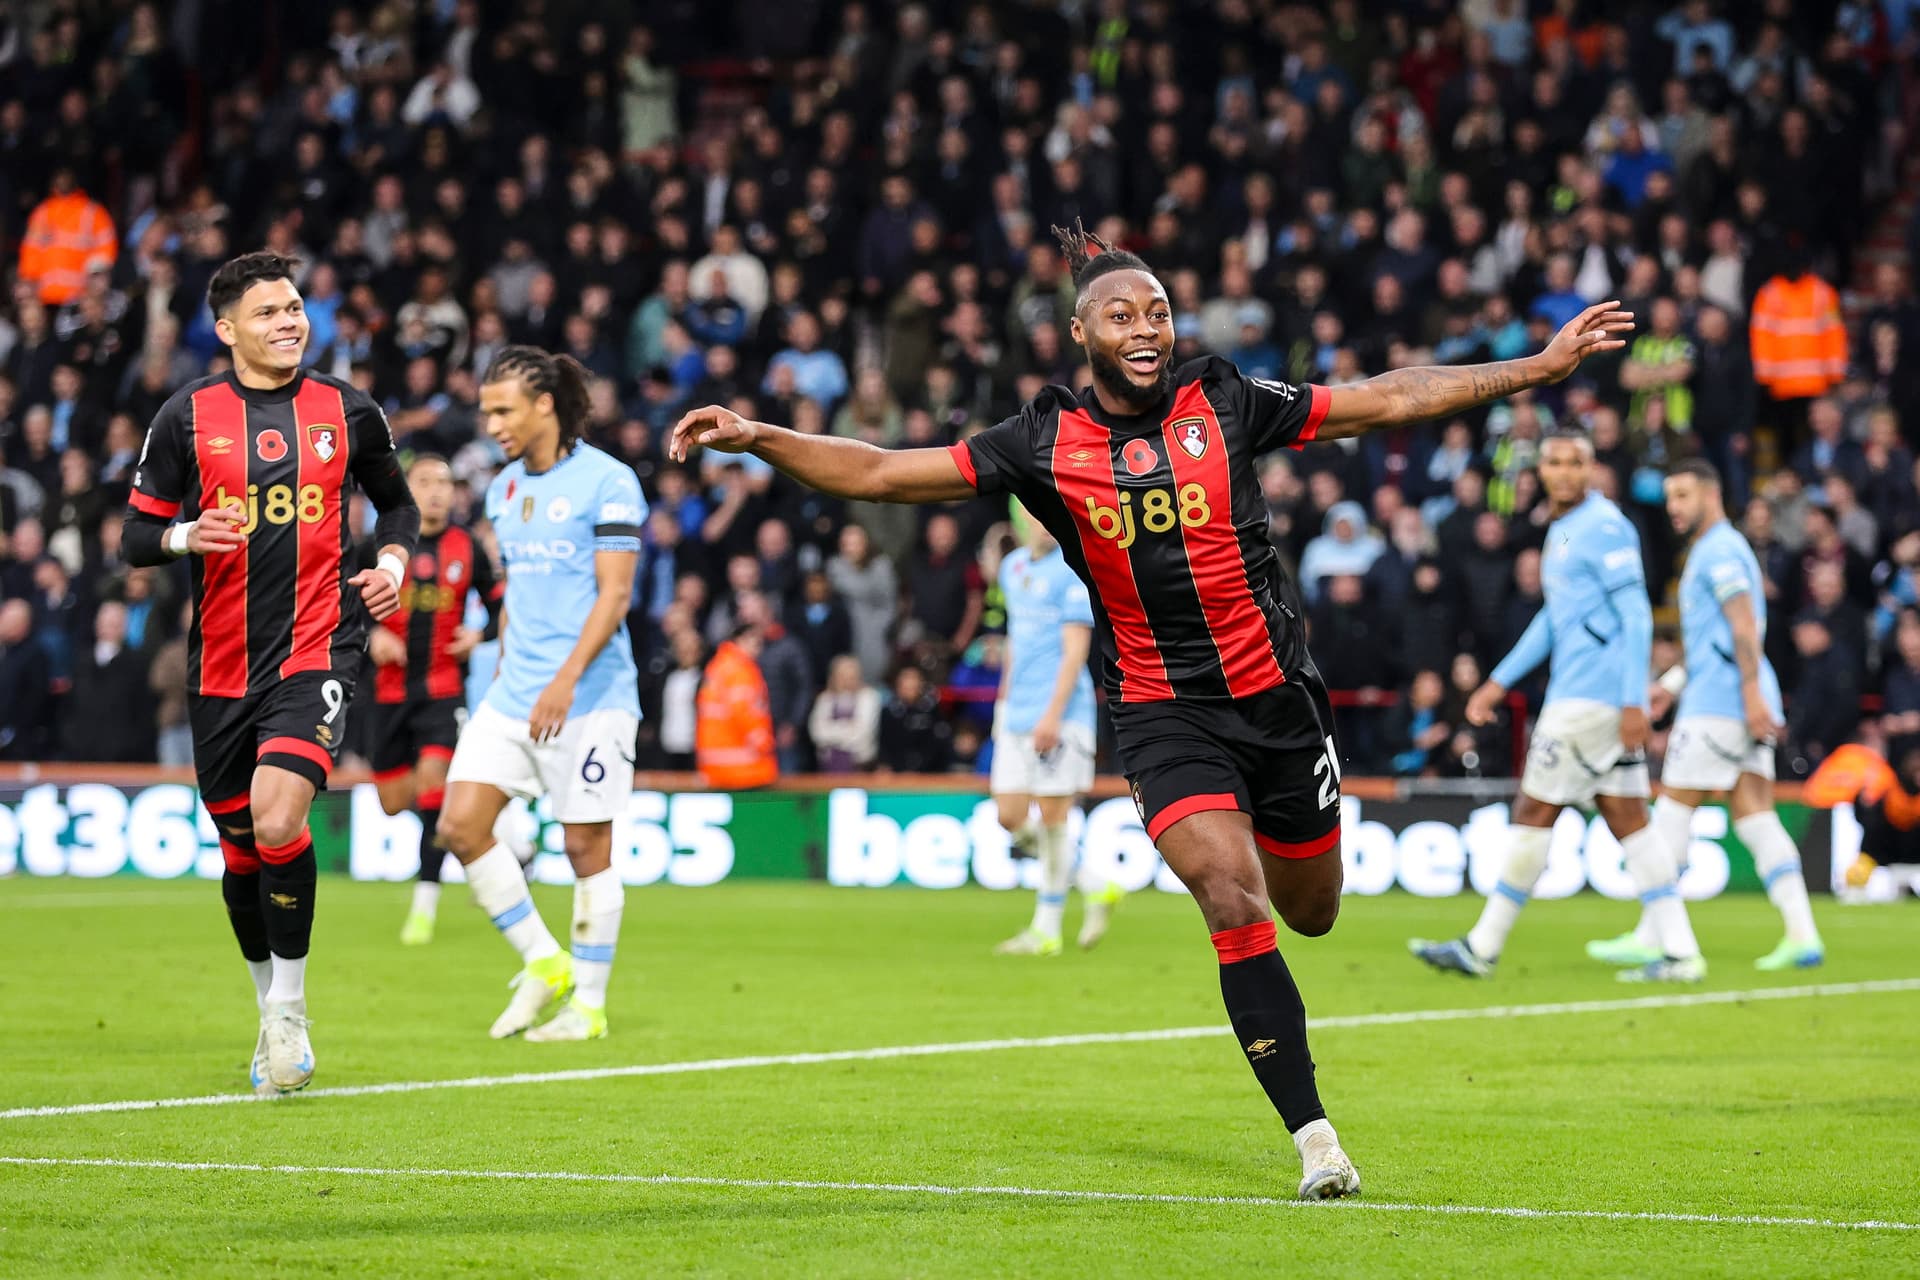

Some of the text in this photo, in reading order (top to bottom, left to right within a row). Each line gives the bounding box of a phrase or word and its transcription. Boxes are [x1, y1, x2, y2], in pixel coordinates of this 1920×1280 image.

[217, 484, 325, 535] bj88
[1085, 483, 1211, 549] bj88
[502, 539, 577, 561] TIHAD
[321, 679, 343, 724] 9
[582, 746, 605, 783] 6
[827, 788, 1197, 894] bet6
